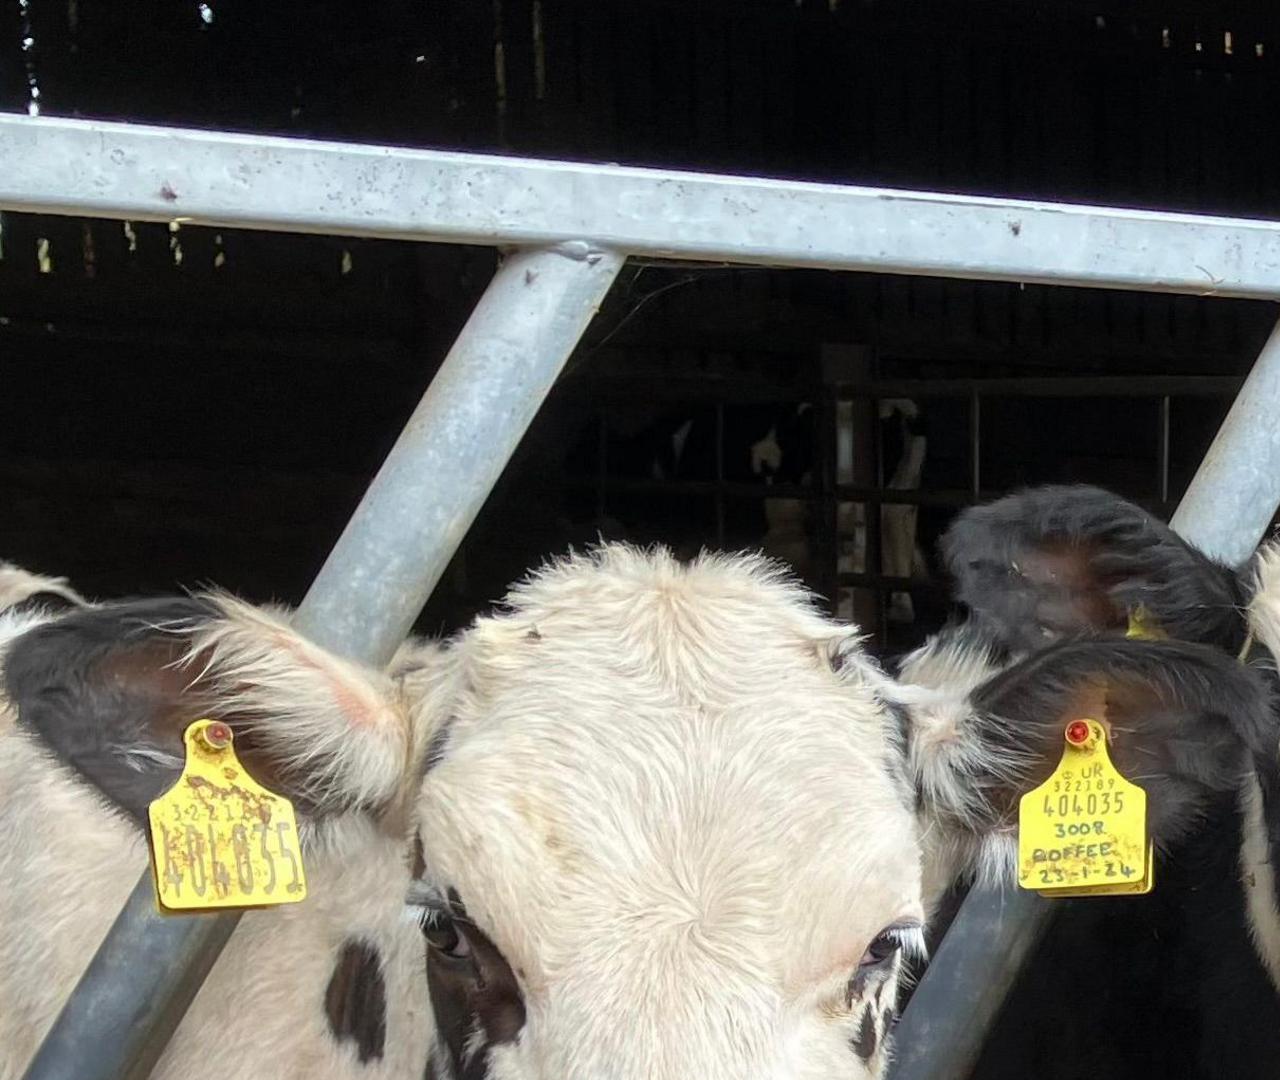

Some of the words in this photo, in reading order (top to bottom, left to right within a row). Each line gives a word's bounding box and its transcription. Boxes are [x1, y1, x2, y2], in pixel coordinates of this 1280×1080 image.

[1082, 763, 1103, 779] UK
[1054, 778, 1115, 793] 322189
[1043, 792, 1124, 817] 404035
[1039, 863, 1136, 884] 23-1-24
